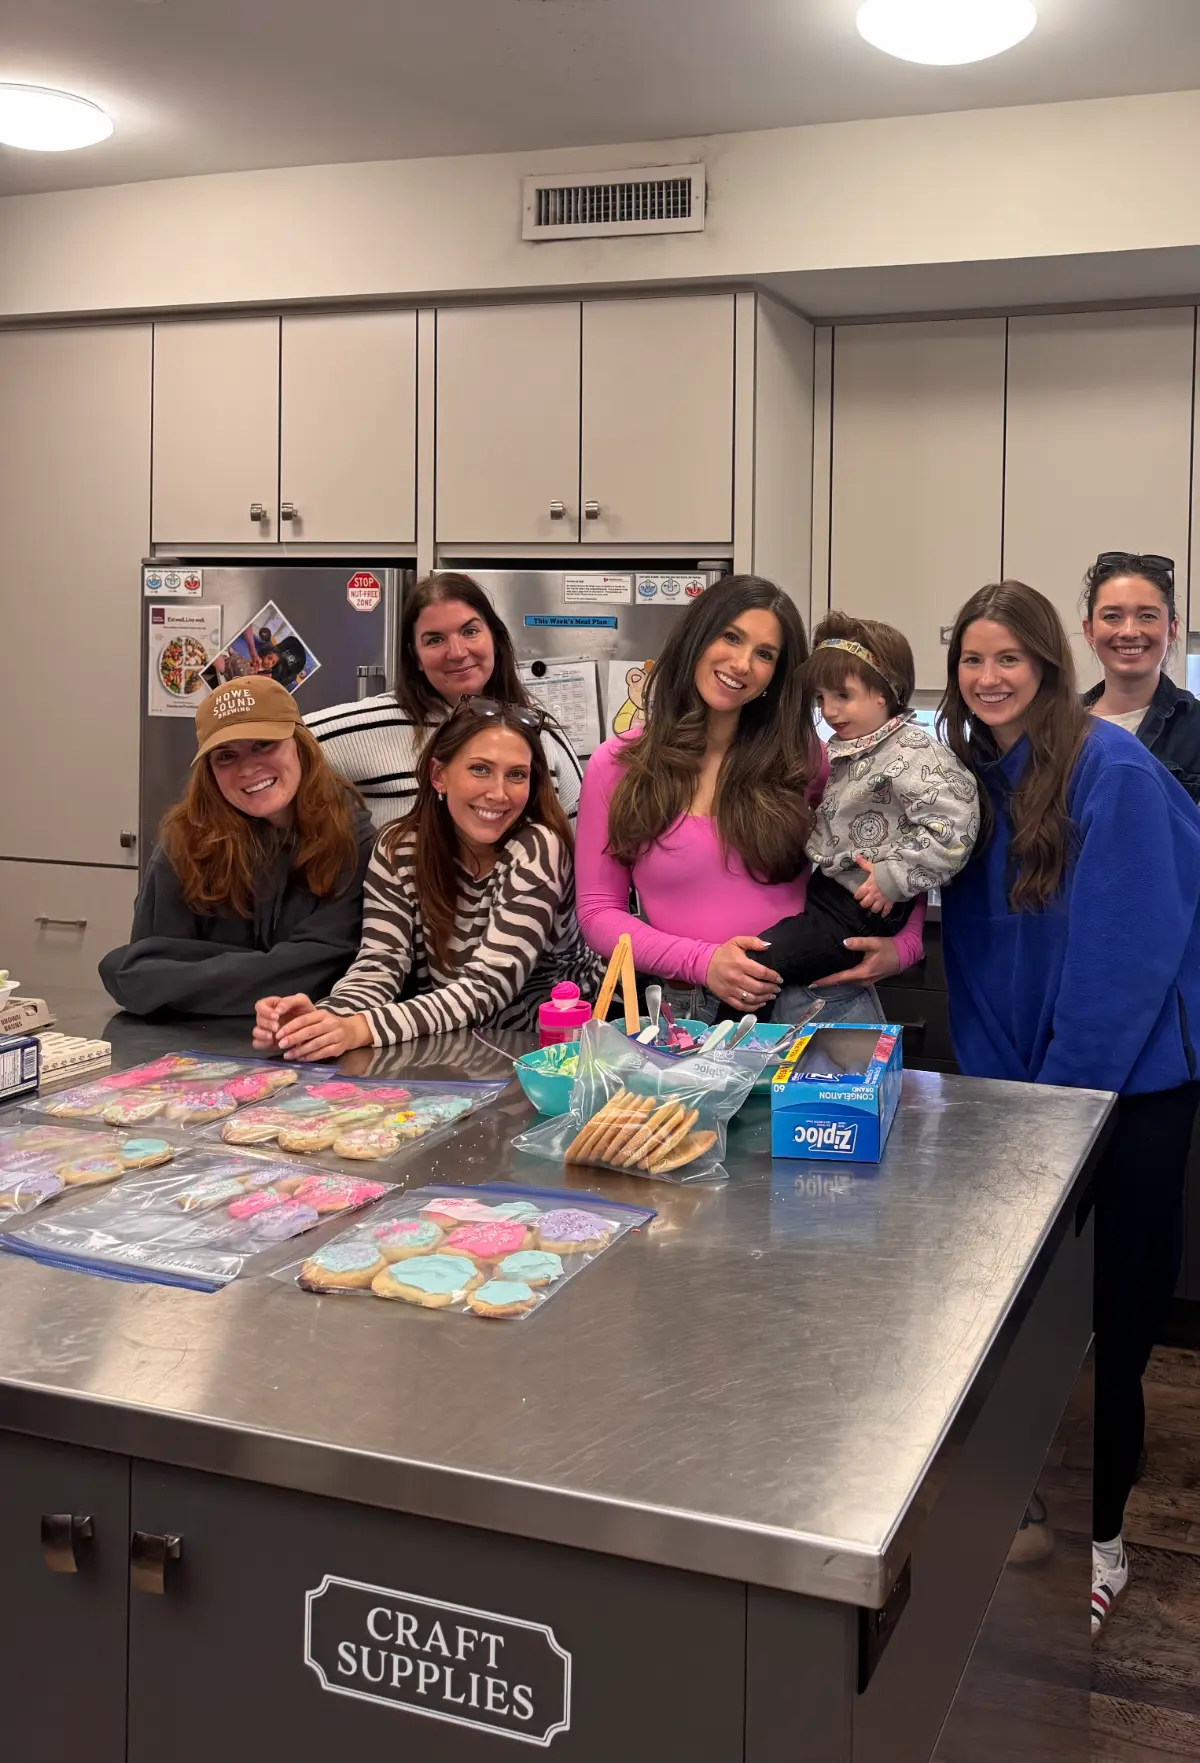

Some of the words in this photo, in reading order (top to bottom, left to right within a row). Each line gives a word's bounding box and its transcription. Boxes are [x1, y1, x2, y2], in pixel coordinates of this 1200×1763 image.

[354, 577, 374, 588] STOP
[350, 590, 378, 598] NUT-FREE
[356, 598, 373, 607] ZONE
[533, 617, 548, 625] This
[549, 617, 573, 625] Week's
[215, 689, 251, 705] HOWE
[213, 697, 256, 716] SOUND
[217, 706, 251, 720] BREWING
[0, 1014, 22, 1026] BROWN
[3, 1020, 23, 1032] BRUNS
[773, 1085, 785, 1093] 60
[819, 1091, 874, 1102] CONGÉLATION
[794, 1122, 852, 1150] Ziploc
[366, 1606, 505, 1668] CRAFT
[337, 1640, 534, 1720] SUPPLIES
